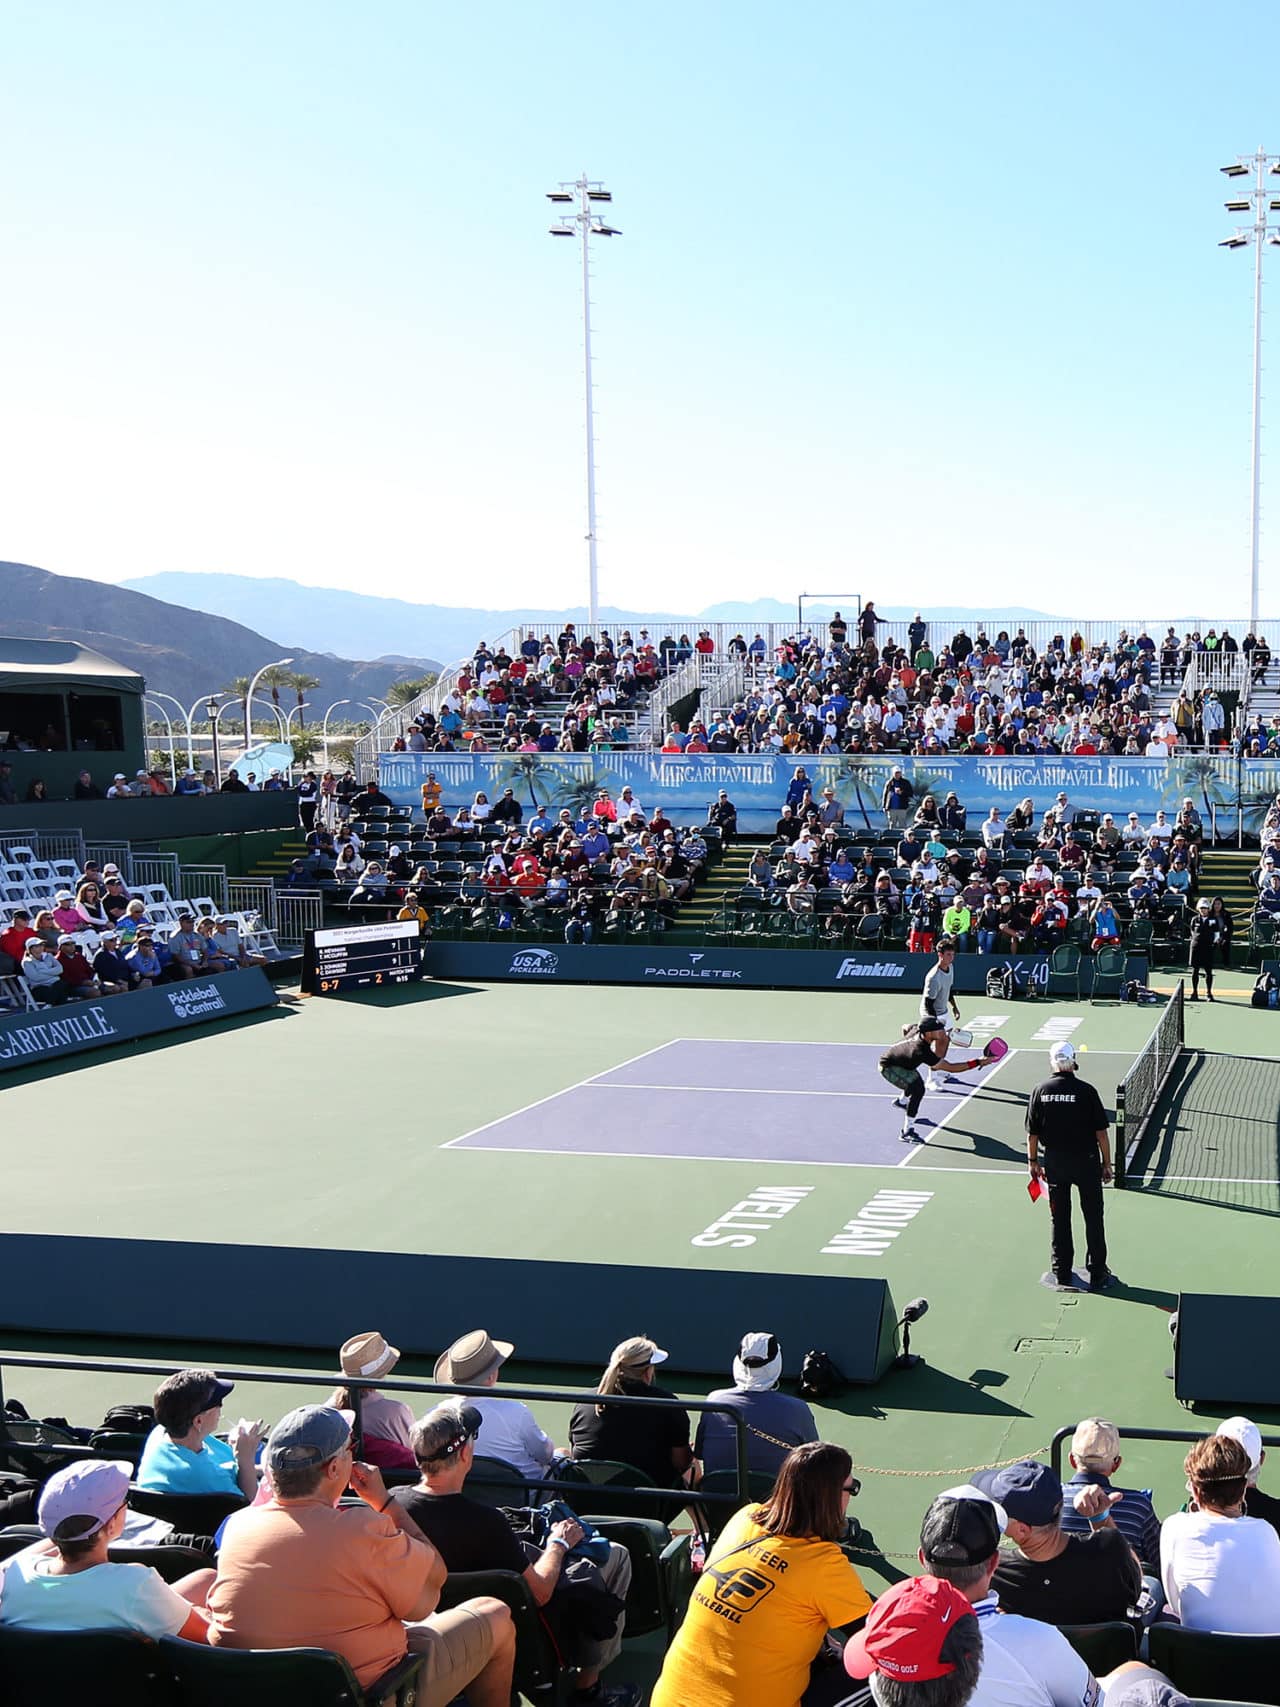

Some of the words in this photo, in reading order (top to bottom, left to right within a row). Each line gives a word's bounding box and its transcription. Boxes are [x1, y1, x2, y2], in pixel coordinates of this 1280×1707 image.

[650, 761, 773, 783] MARGARITAVILLE
[986, 765, 1116, 786] MARGARITAVILLE
[513, 957, 541, 967] USA
[375, 973, 382, 984] 2
[644, 967, 743, 978] PADDLETEK
[321, 979, 339, 992] 9-7
[168, 984, 219, 1005] Pickleball
[185, 996, 225, 1015] Central
[1041, 1094, 1076, 1102] REFEREE
[691, 1186, 816, 1247] WELLS
[819, 1189, 935, 1256] INDIAN
[900, 1664, 918, 1673] GOLF
